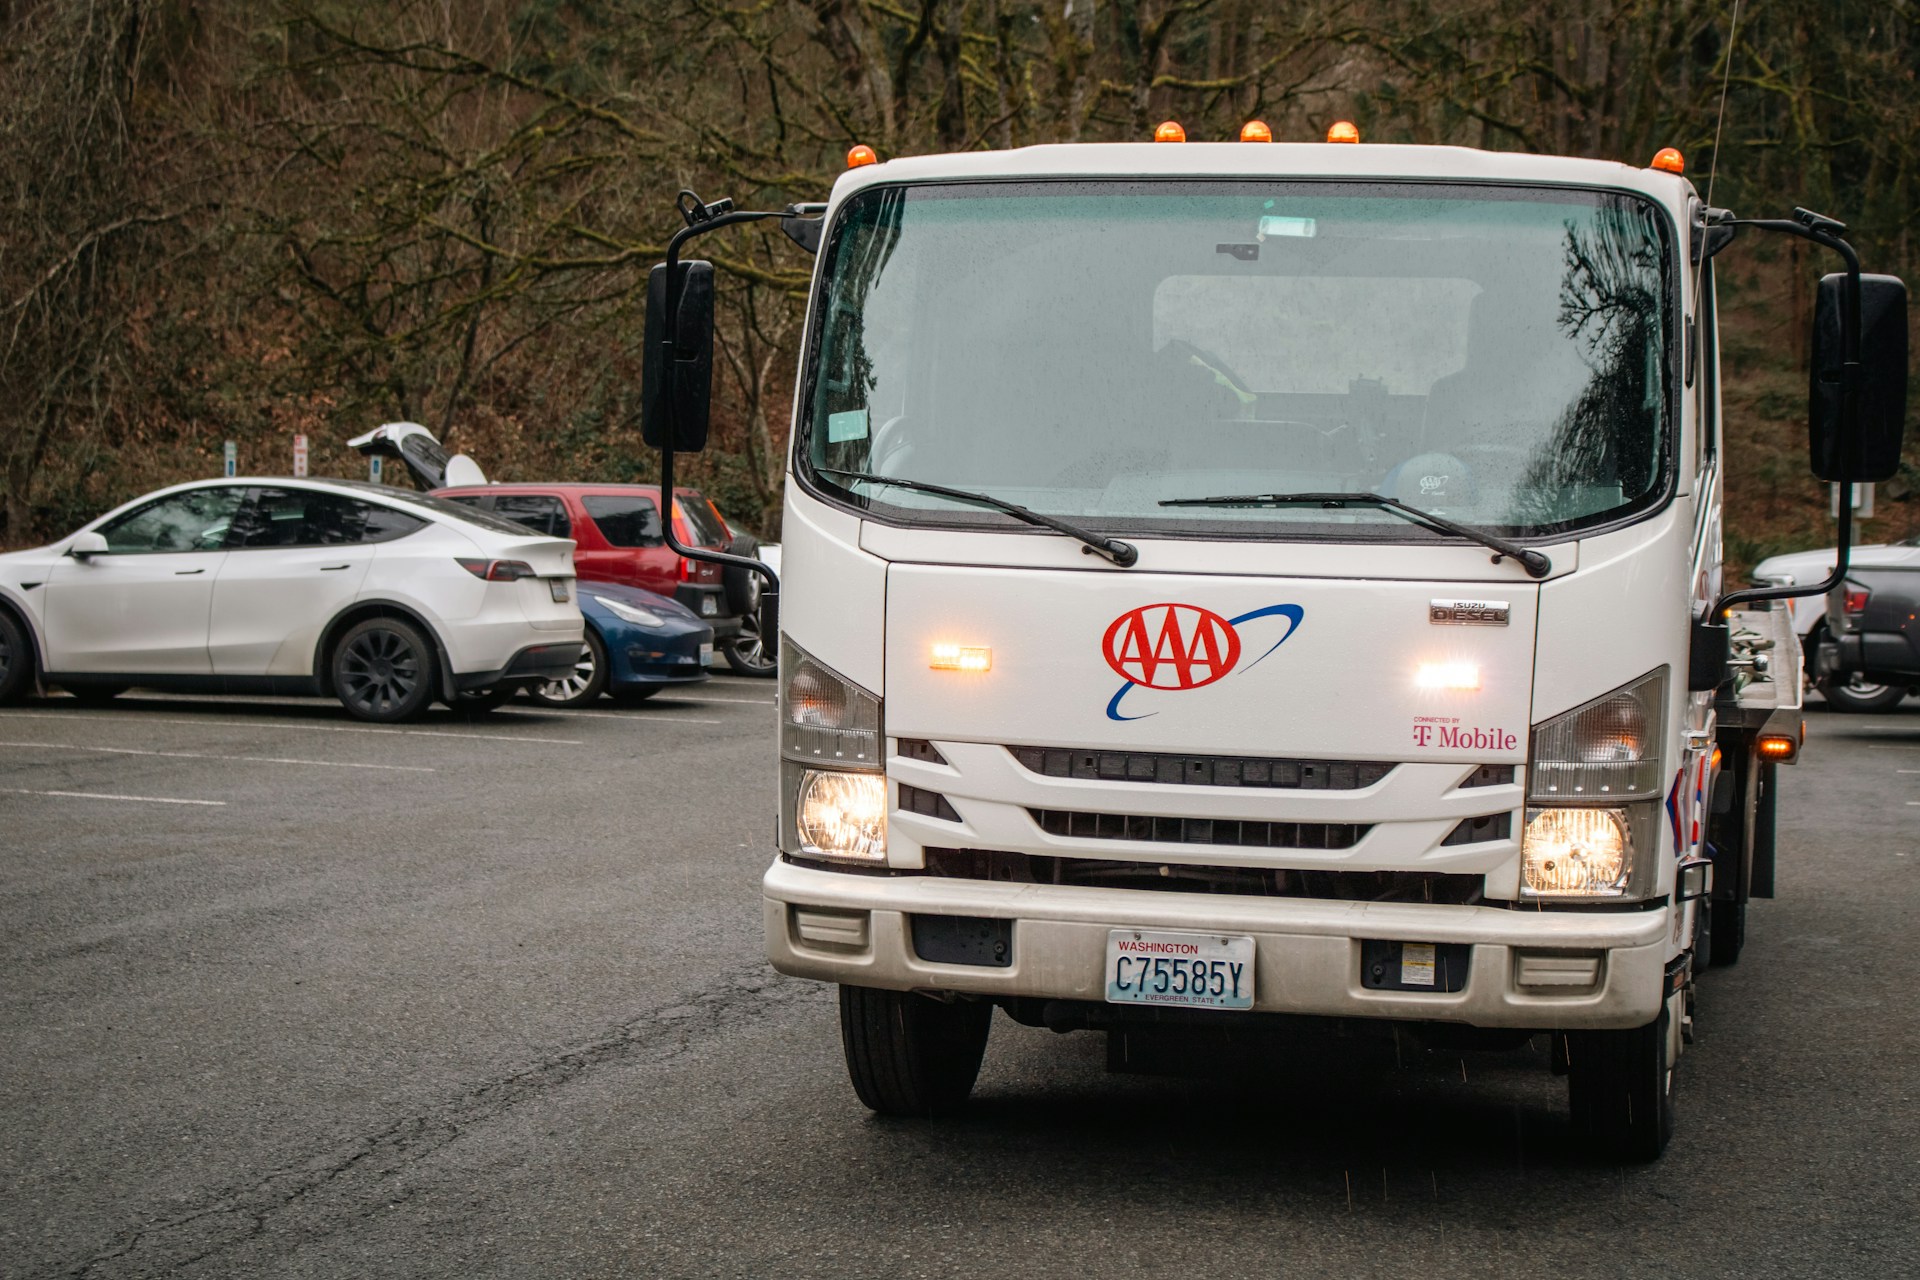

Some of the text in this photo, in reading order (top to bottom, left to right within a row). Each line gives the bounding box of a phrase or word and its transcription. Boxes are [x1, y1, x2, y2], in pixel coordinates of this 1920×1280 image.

[1433, 609, 1505, 622] DIESEL
[1114, 605, 1228, 690] AAA
[1118, 941, 1198, 954] WASHINGTON
[1116, 956, 1243, 998] C75585Y
[1145, 994, 1189, 1002] EVERGREEN
